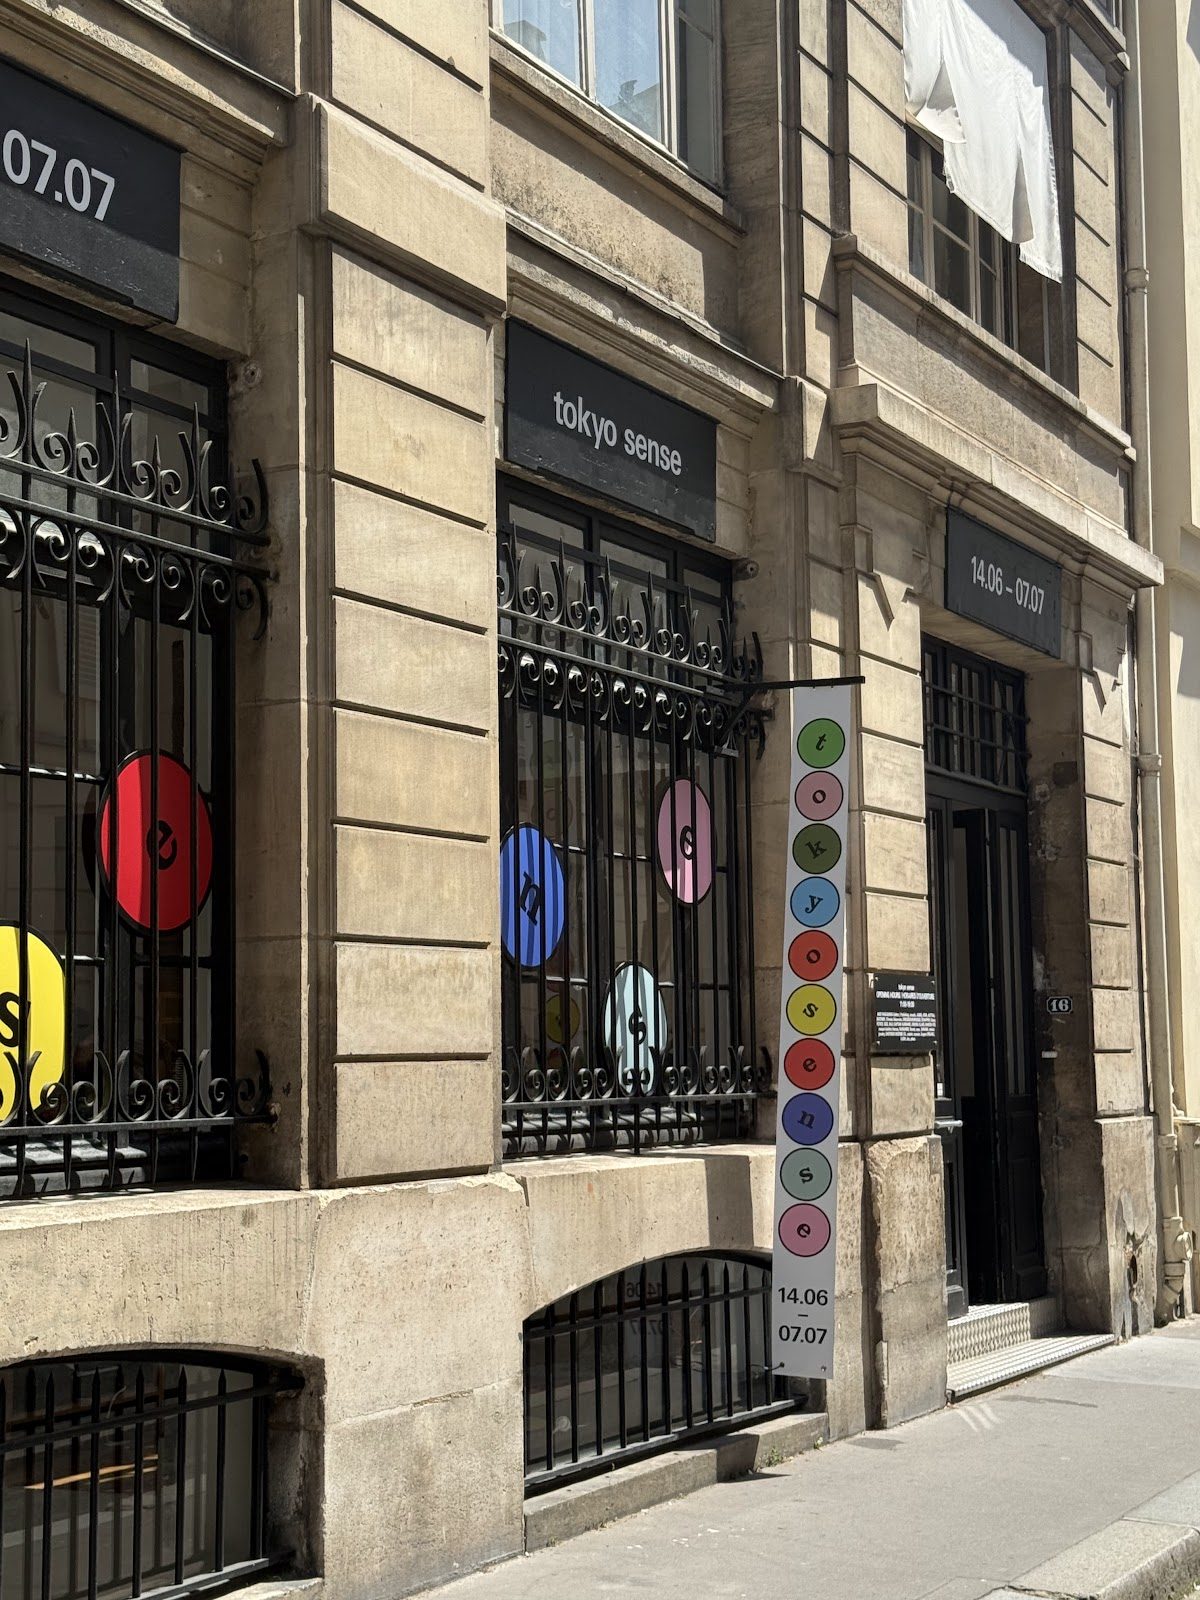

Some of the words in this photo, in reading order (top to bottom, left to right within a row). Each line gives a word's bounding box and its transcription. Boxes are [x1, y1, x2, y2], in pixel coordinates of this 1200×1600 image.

[3, 129, 115, 222] 07.07
[553, 391, 617, 450] tokyo
[624, 428, 682, 476] sense
[971, 555, 1003, 596] 14.06
[1015, 577, 1045, 615] 07.07
[519, 871, 543, 926] n
[1050, 999, 1069, 1012] 16
[778, 1287, 828, 1306] 14.06
[778, 1325, 828, 1344] 07.07
